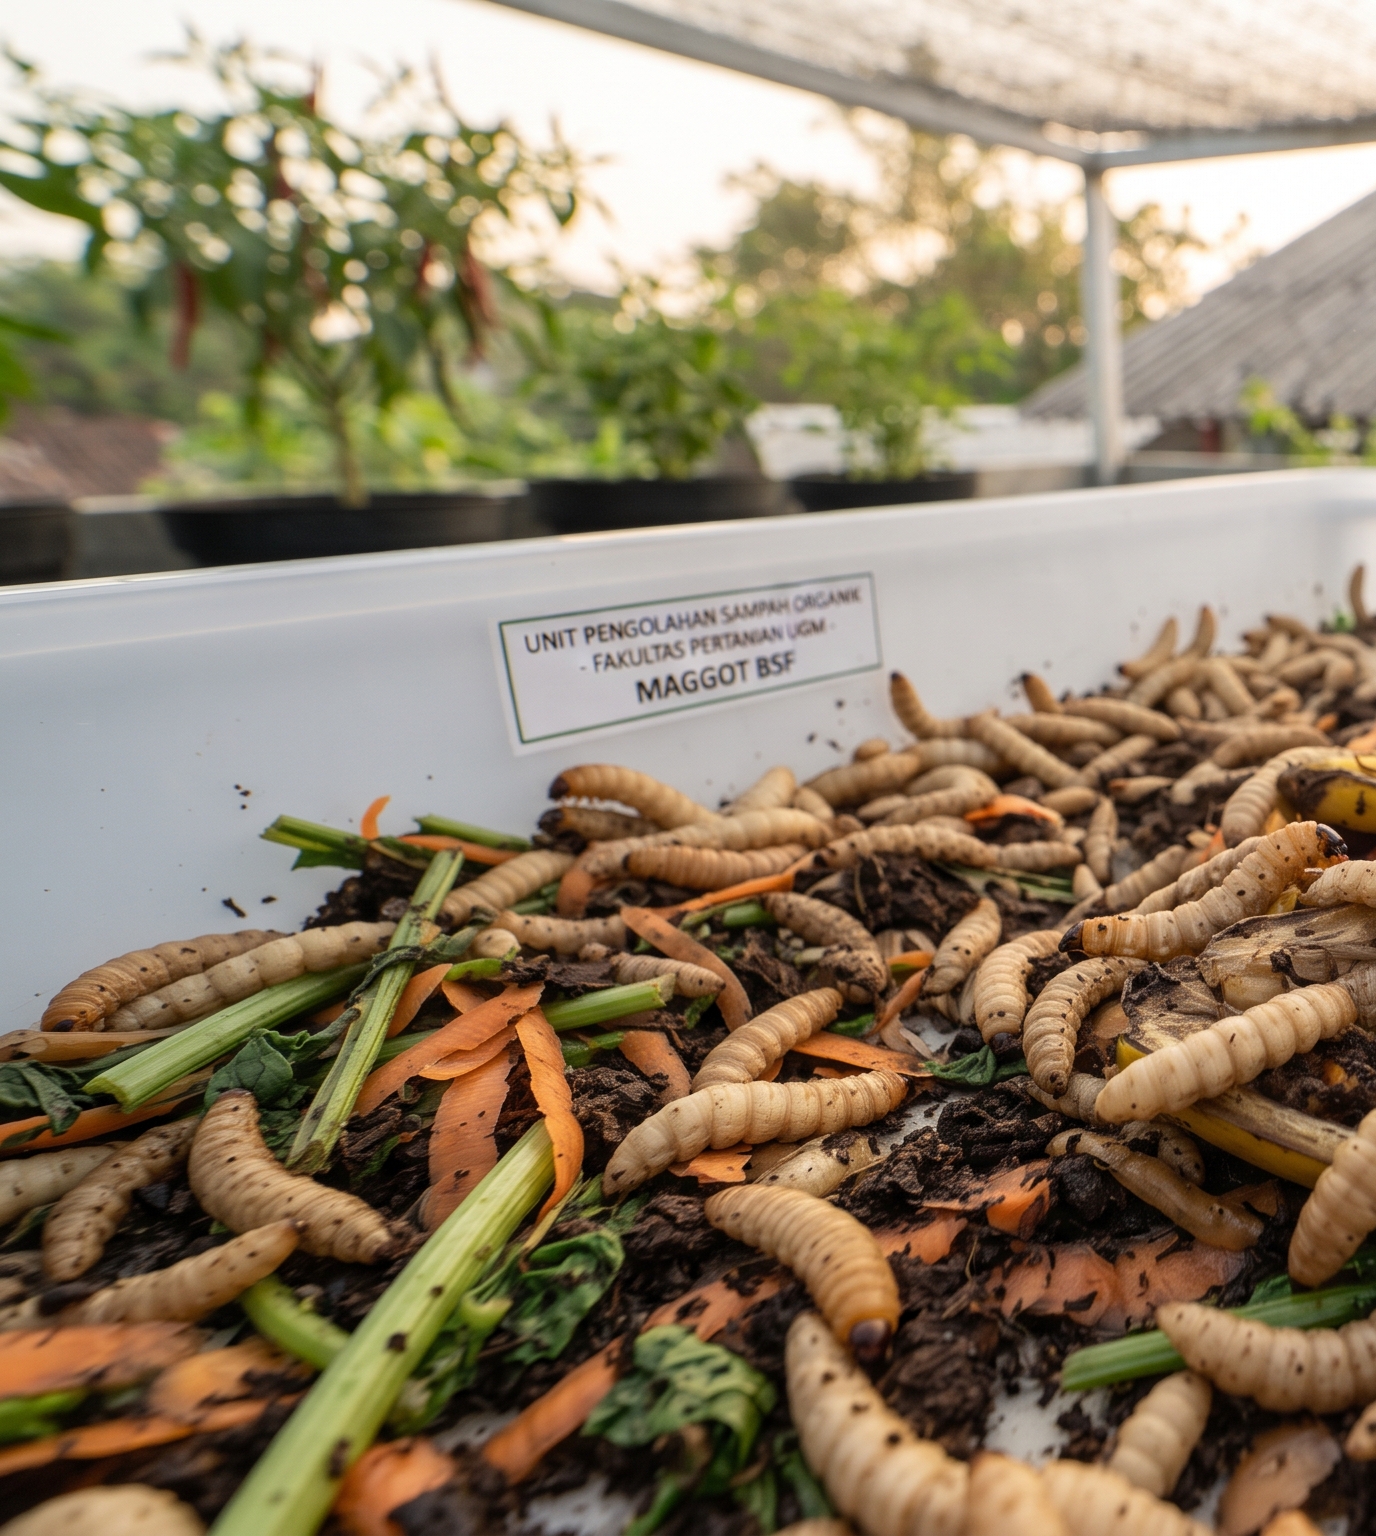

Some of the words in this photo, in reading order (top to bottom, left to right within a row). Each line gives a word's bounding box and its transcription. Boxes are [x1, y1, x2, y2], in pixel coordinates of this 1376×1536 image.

[524, 628, 578, 654] UNIT
[584, 609, 717, 645] PENGOLAHAN
[720, 597, 790, 624] SAMPAH
[593, 641, 685, 673] FAKULTAS
[690, 623, 783, 656] PERTANIAN
[786, 618, 826, 641] UGM
[636, 660, 749, 705] MAGGOT
[757, 650, 797, 680] BSF
